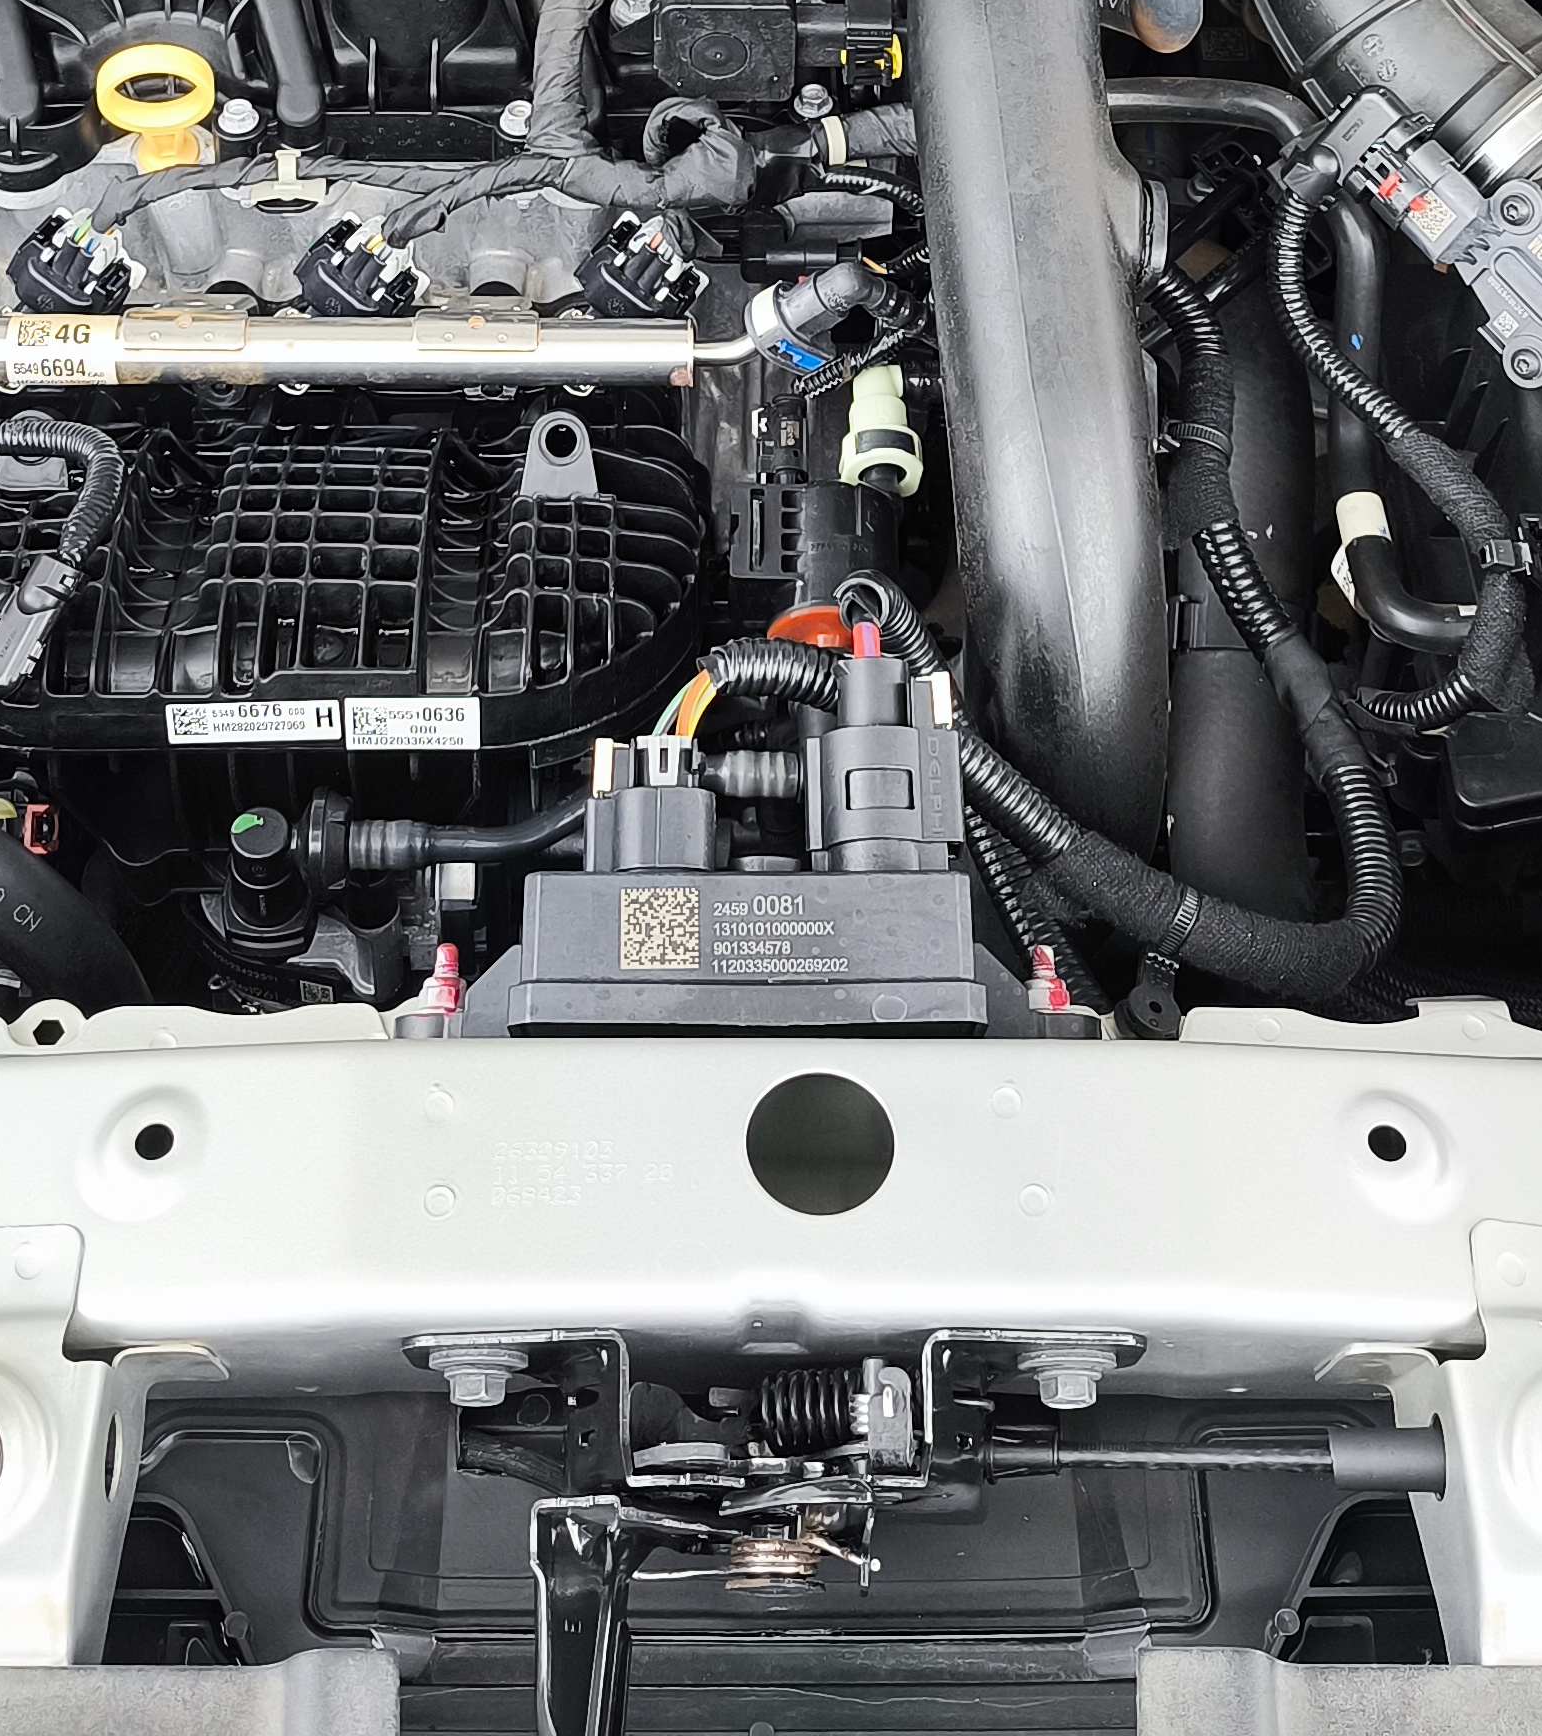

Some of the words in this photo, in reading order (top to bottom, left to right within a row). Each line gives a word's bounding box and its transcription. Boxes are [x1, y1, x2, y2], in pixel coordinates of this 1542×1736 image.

[54, 323, 91, 344] 4G
[238, 704, 282, 718] 6676
[315, 706, 335, 728] H
[409, 724, 437, 735] 000
[713, 902, 748, 916] 2459
[752, 894, 805, 915] 0081
[12, 903, 45, 933] CN
[713, 920, 835, 936] 1310101000000X
[713, 940, 791, 955] 901334578
[711, 957, 849, 974] 1120335000269202
